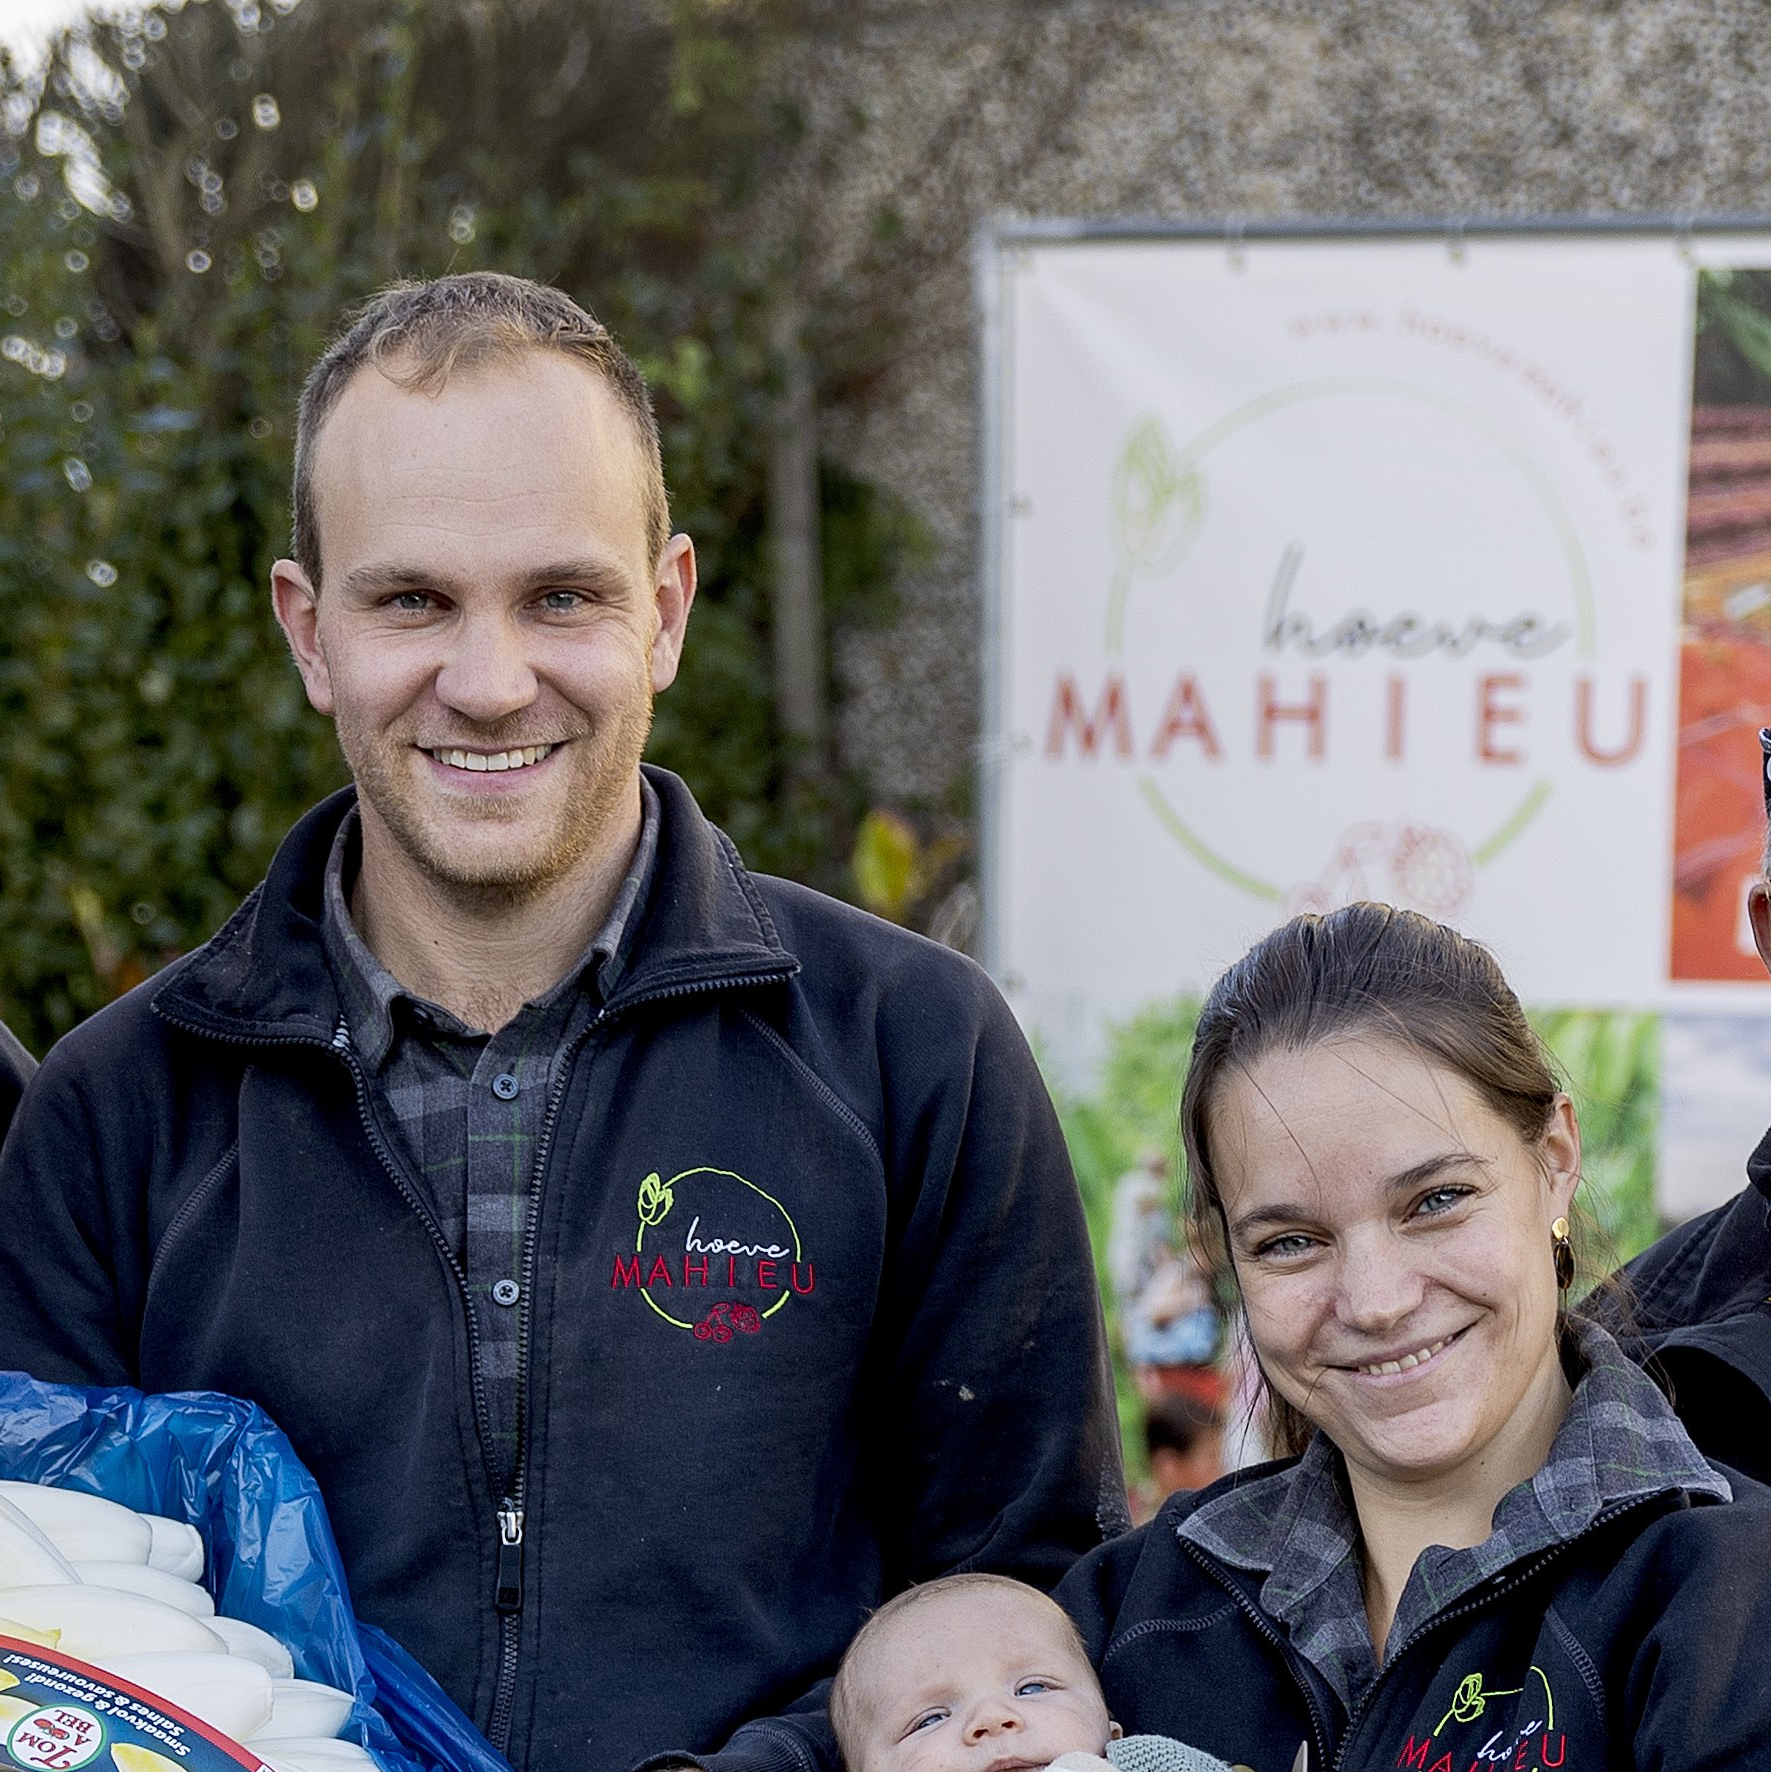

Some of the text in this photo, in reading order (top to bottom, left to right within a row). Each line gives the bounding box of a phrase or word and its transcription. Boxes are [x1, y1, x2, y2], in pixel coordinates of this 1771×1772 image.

[1261, 542, 1569, 659] hoeve
[1043, 670, 1651, 768] MAHIEU
[685, 1216, 790, 1258] hoeve
[611, 1253, 815, 1294] MAHIEU
[2, 1653, 185, 1736] Saines & savoureuses!
[23, 1672, 191, 1757] Smaakvol & gezond!
[54, 1709, 95, 1734] BEL
[74, 1733, 92, 1746] A
[15, 1731, 78, 1771] TOM
